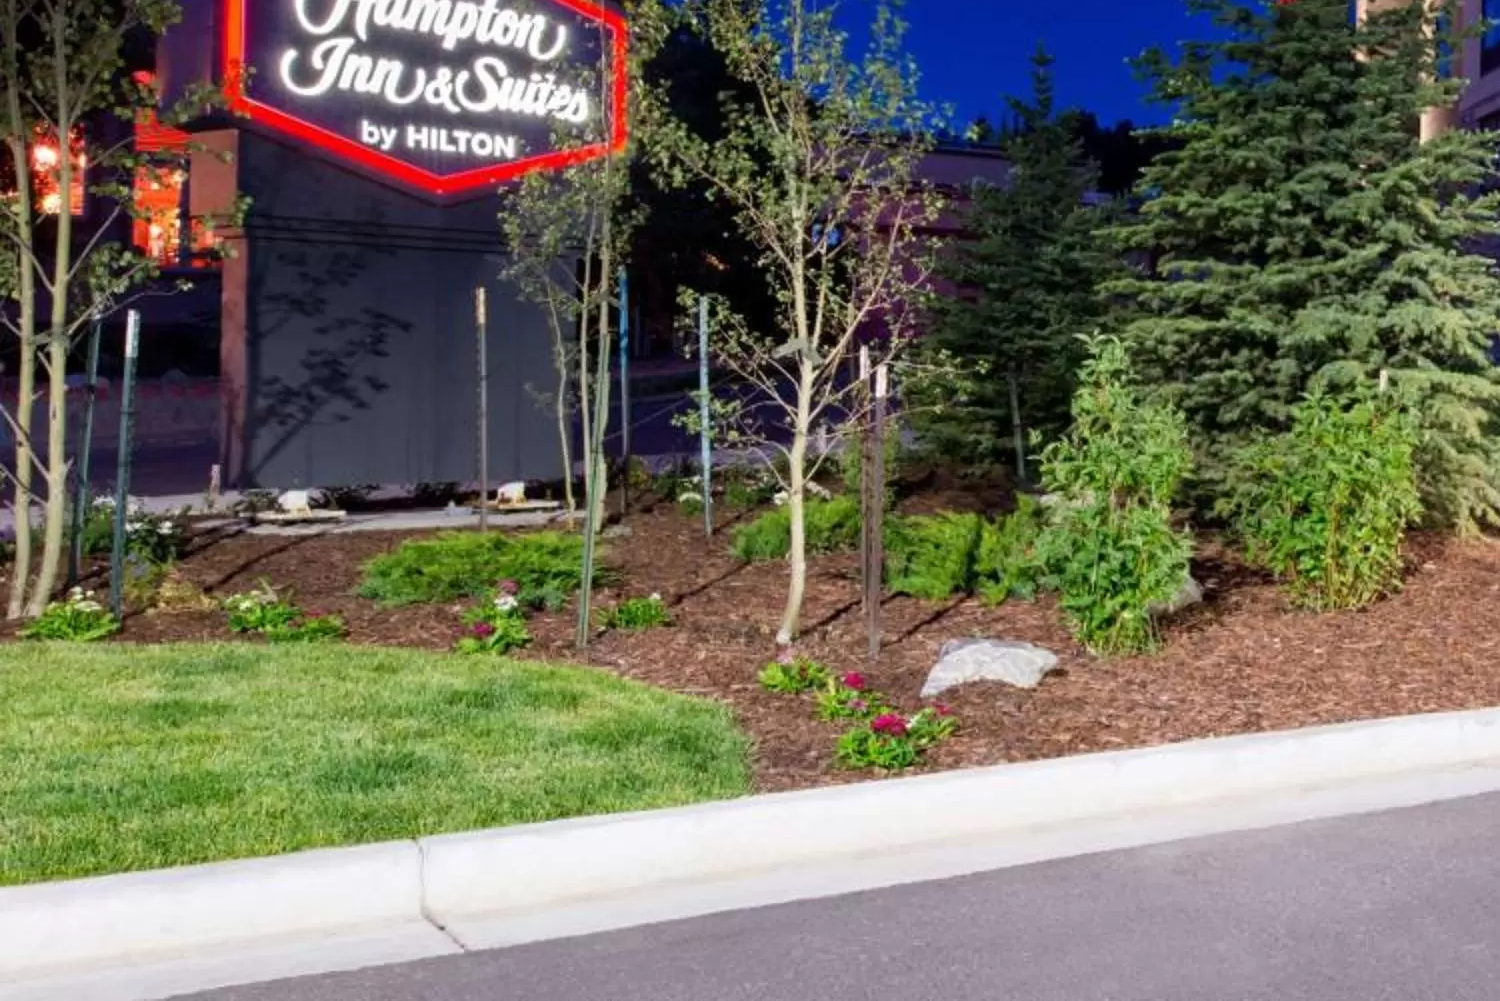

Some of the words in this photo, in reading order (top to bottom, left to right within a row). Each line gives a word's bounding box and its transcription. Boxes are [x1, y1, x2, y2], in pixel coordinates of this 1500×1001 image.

[280, 37, 424, 105] Inn
[425, 68, 461, 113] &
[455, 56, 590, 123] Suites
[360, 120, 397, 151] by
[407, 126, 516, 159] HILTON
